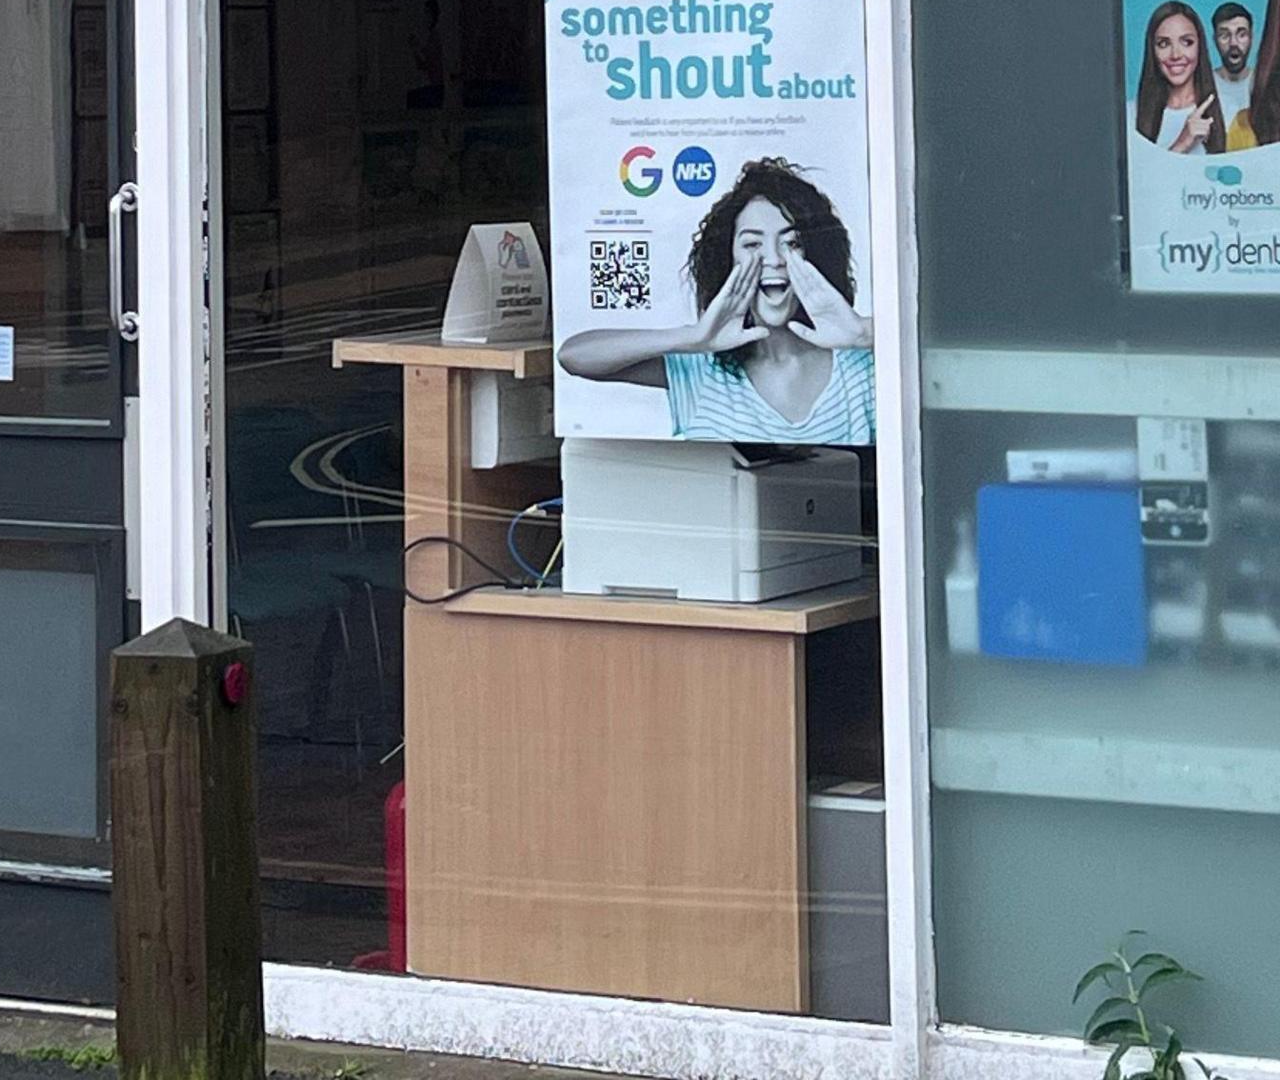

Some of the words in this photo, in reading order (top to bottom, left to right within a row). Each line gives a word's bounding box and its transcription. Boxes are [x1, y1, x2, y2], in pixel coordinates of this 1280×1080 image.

[582, 38, 610, 63] to
[605, 40, 775, 102] shout
[777, 72, 856, 100] about
[675, 163, 713, 181] NHS
